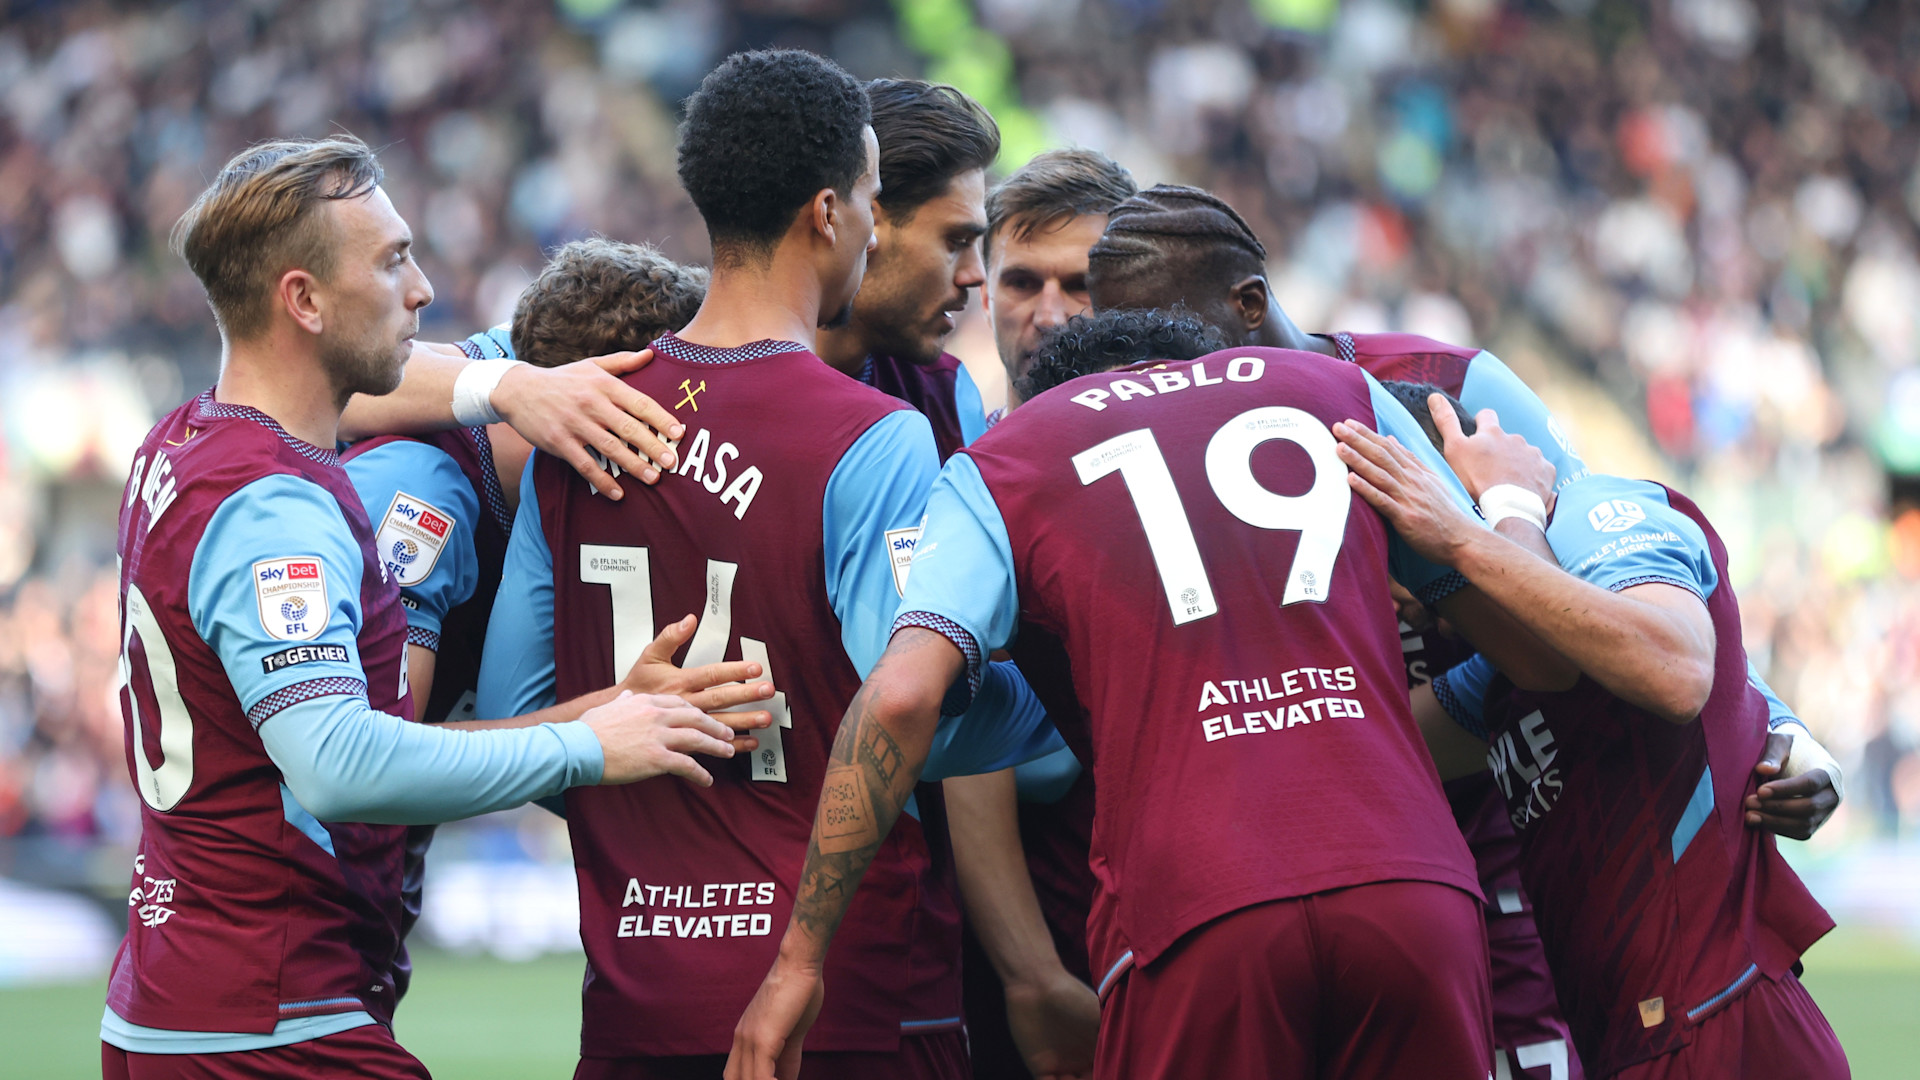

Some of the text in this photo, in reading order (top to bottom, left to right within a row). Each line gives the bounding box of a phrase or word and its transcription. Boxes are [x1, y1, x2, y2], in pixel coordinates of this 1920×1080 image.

[1070, 357, 1266, 411] PABLO
[396, 503, 446, 533] sky bet
[1070, 406, 1351, 627] 19
[389, 517, 441, 546] CHAMPIONSHIP
[893, 537, 917, 551] sky
[1615, 542, 1653, 558] RISKS
[600, 564, 637, 572] COMMUNITY
[619, 558, 629, 566] THE
[260, 564, 316, 581] sky bet
[262, 581, 321, 595] CHAMPIONSHIP
[1303, 587, 1318, 596] EFL
[1186, 606, 1203, 616] EFL
[286, 622, 309, 635] EFL
[578, 542, 792, 783] 14
[1198, 666, 1357, 712] ATHLETES
[1202, 697, 1365, 742] ELEVATED
[764, 767, 778, 776] EFL
[622, 877, 775, 908] ATHLETES
[617, 913, 772, 938] ELEVATED
